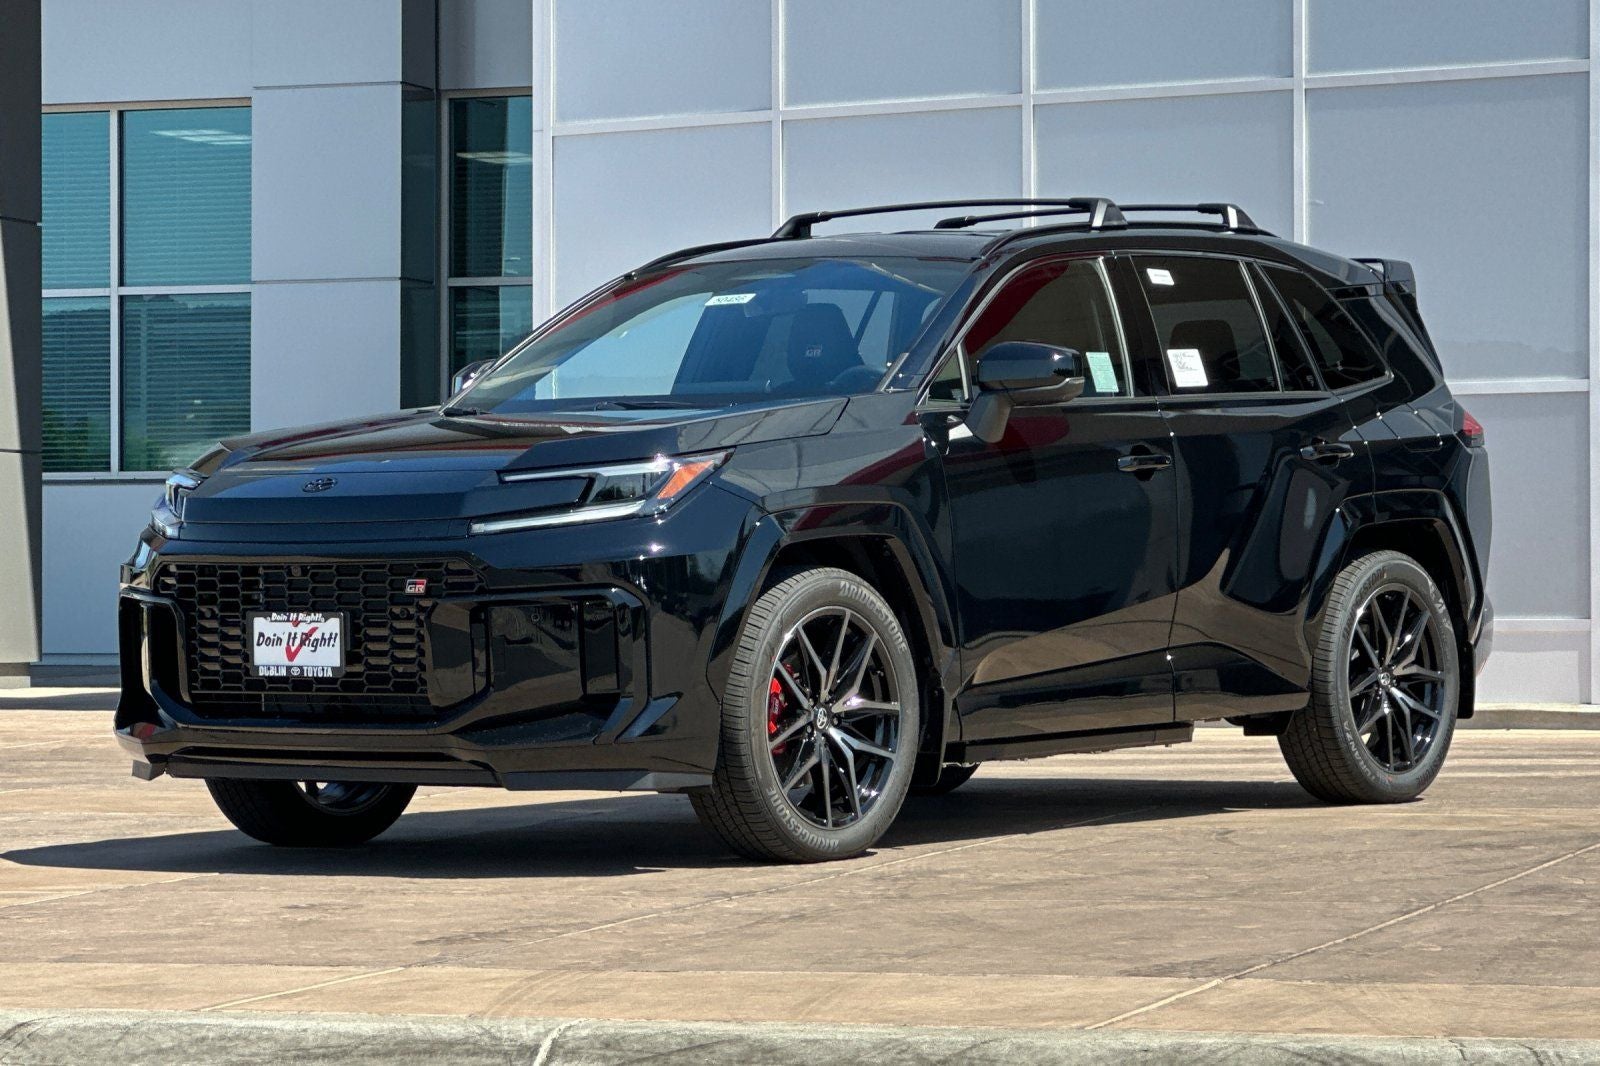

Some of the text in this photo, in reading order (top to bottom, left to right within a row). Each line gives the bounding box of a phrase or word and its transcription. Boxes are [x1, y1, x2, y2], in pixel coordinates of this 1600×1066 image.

[406, 583, 425, 593] GR
[256, 631, 338, 652] Doin' It Right!
[259, 666, 332, 677] DUBLIN TOYOTA
